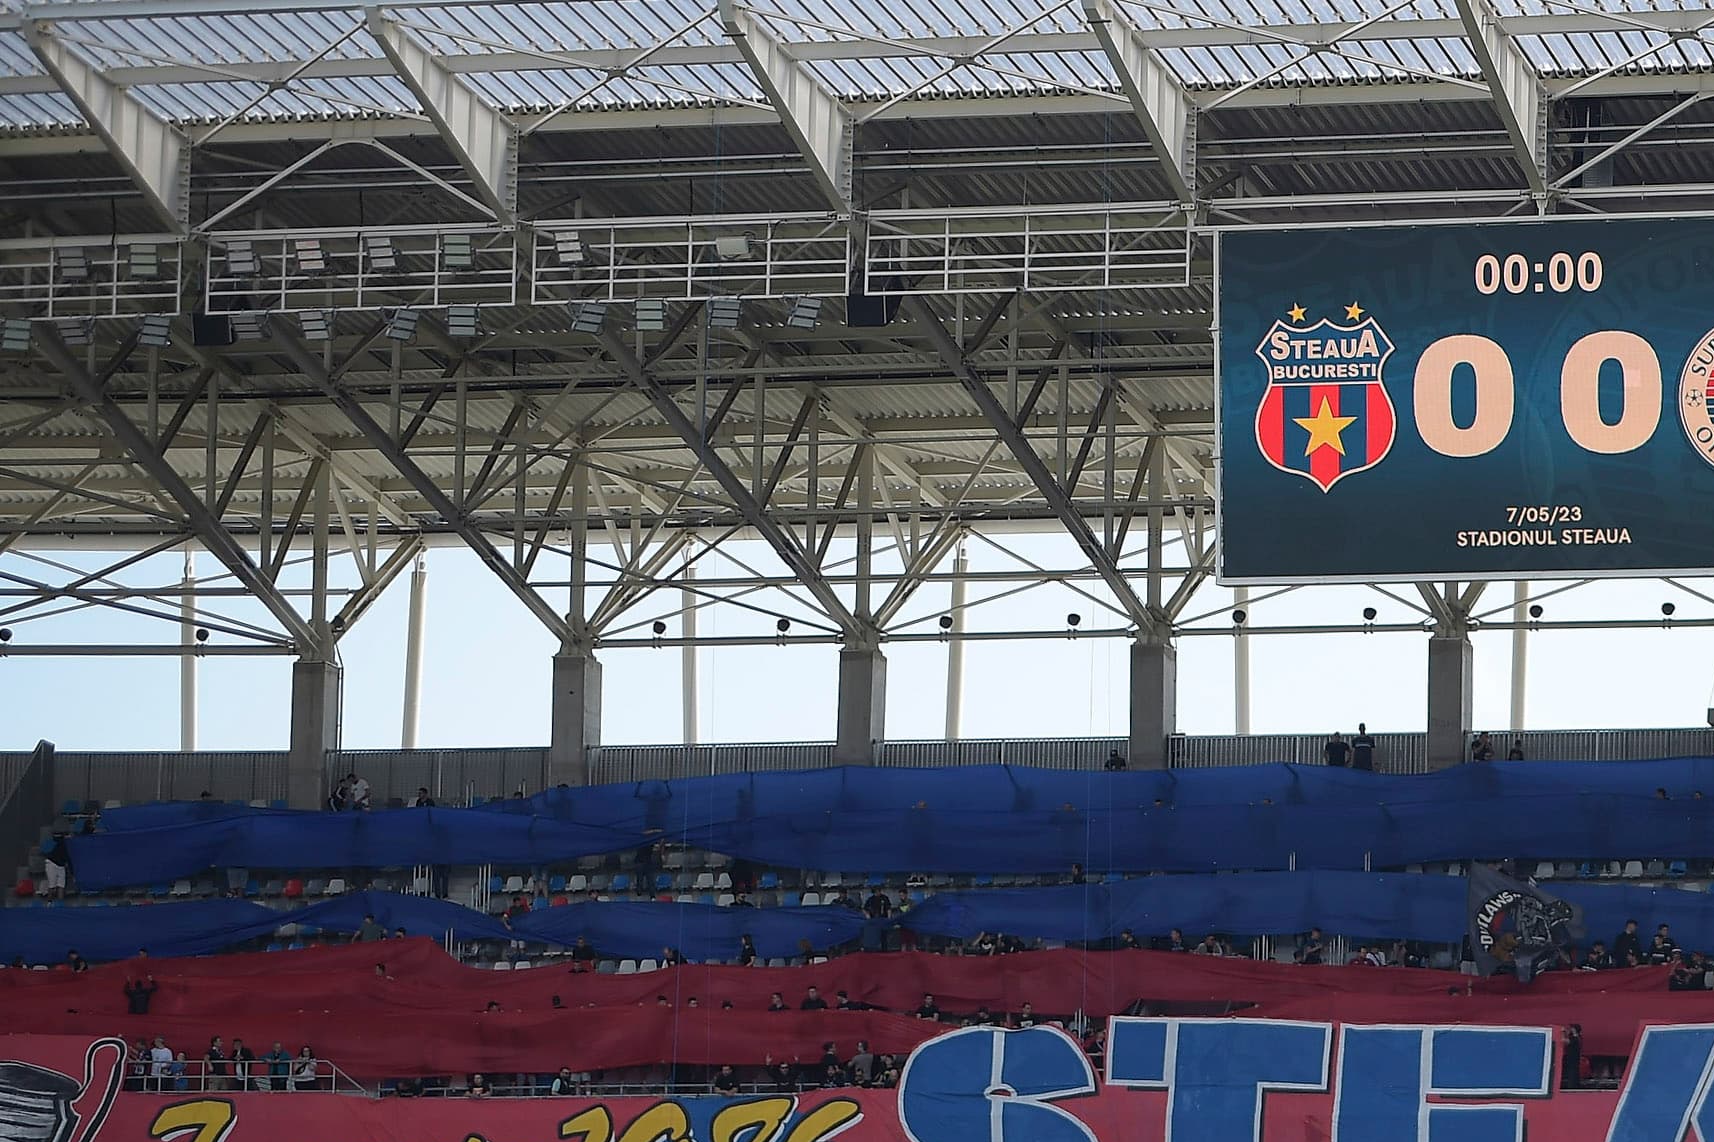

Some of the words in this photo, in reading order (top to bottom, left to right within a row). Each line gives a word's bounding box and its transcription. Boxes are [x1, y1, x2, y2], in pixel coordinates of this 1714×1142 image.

[1475, 252, 1603, 294] 00:00
[1270, 329, 1379, 360] STEAUA
[1273, 363, 1377, 379] BUCURESTI
[1413, 334, 1515, 457] 0
[1560, 330, 1663, 454] 0
[1506, 506, 1582, 527] 7/05/23
[1456, 529, 1557, 547] STADIONUL
[1561, 527, 1632, 544] STEAUA
